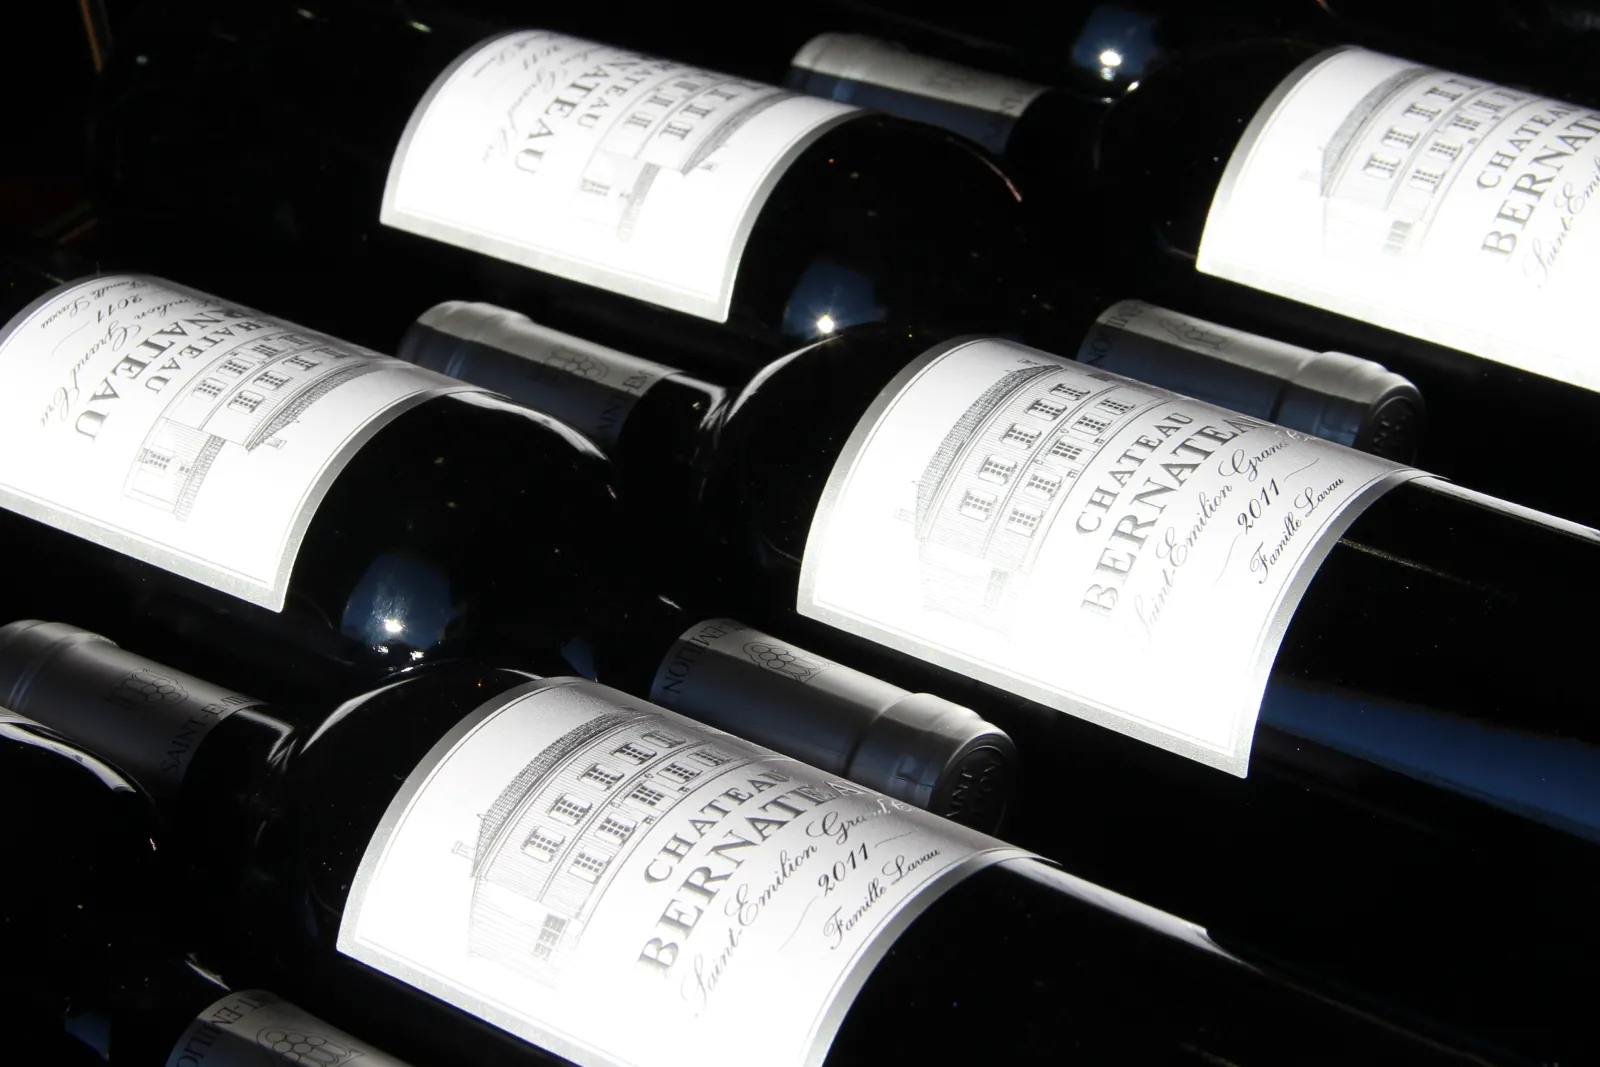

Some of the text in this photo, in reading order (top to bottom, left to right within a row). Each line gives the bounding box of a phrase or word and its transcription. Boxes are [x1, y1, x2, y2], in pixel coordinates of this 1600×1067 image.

[96, 293, 143, 324] 2011
[1075, 411, 1195, 536] CHATEAU
[1236, 477, 1281, 536] 2011
[1249, 477, 1345, 585] Famille Lavau
[643, 769, 794, 885] CHATEAU
[817, 841, 870, 898] 2011
[680, 845, 818, 1019] Saint-Emilion
[823, 848, 941, 951] Famille Lavau
